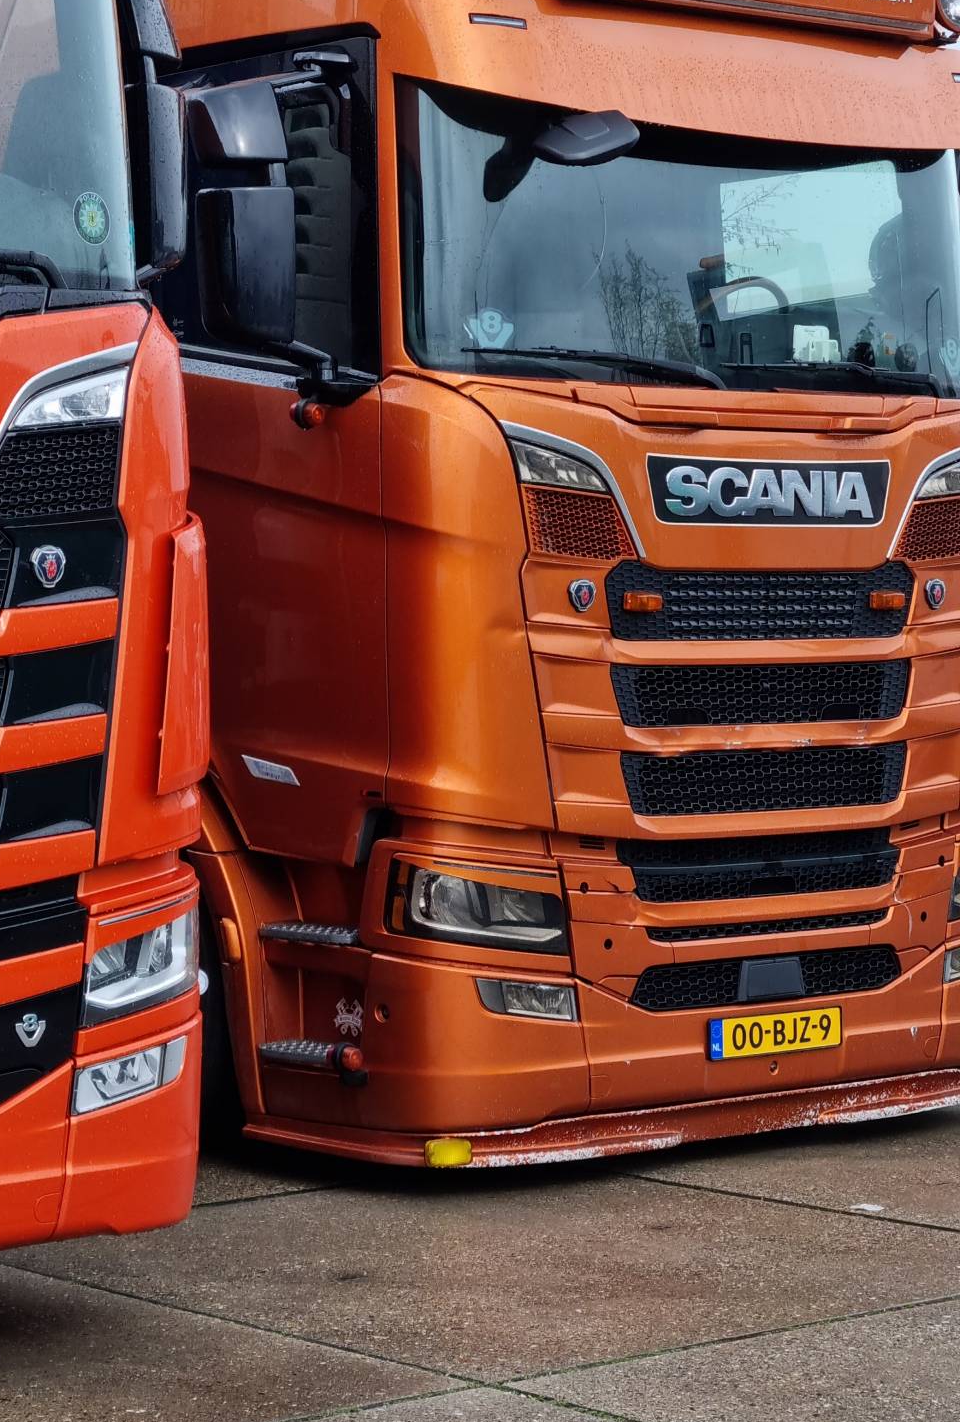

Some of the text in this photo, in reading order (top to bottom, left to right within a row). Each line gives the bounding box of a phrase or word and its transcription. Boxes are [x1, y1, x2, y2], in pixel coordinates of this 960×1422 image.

[665, 465, 874, 519] SCANIA
[712, 1014, 832, 1051] NL 00-BJZ-9
